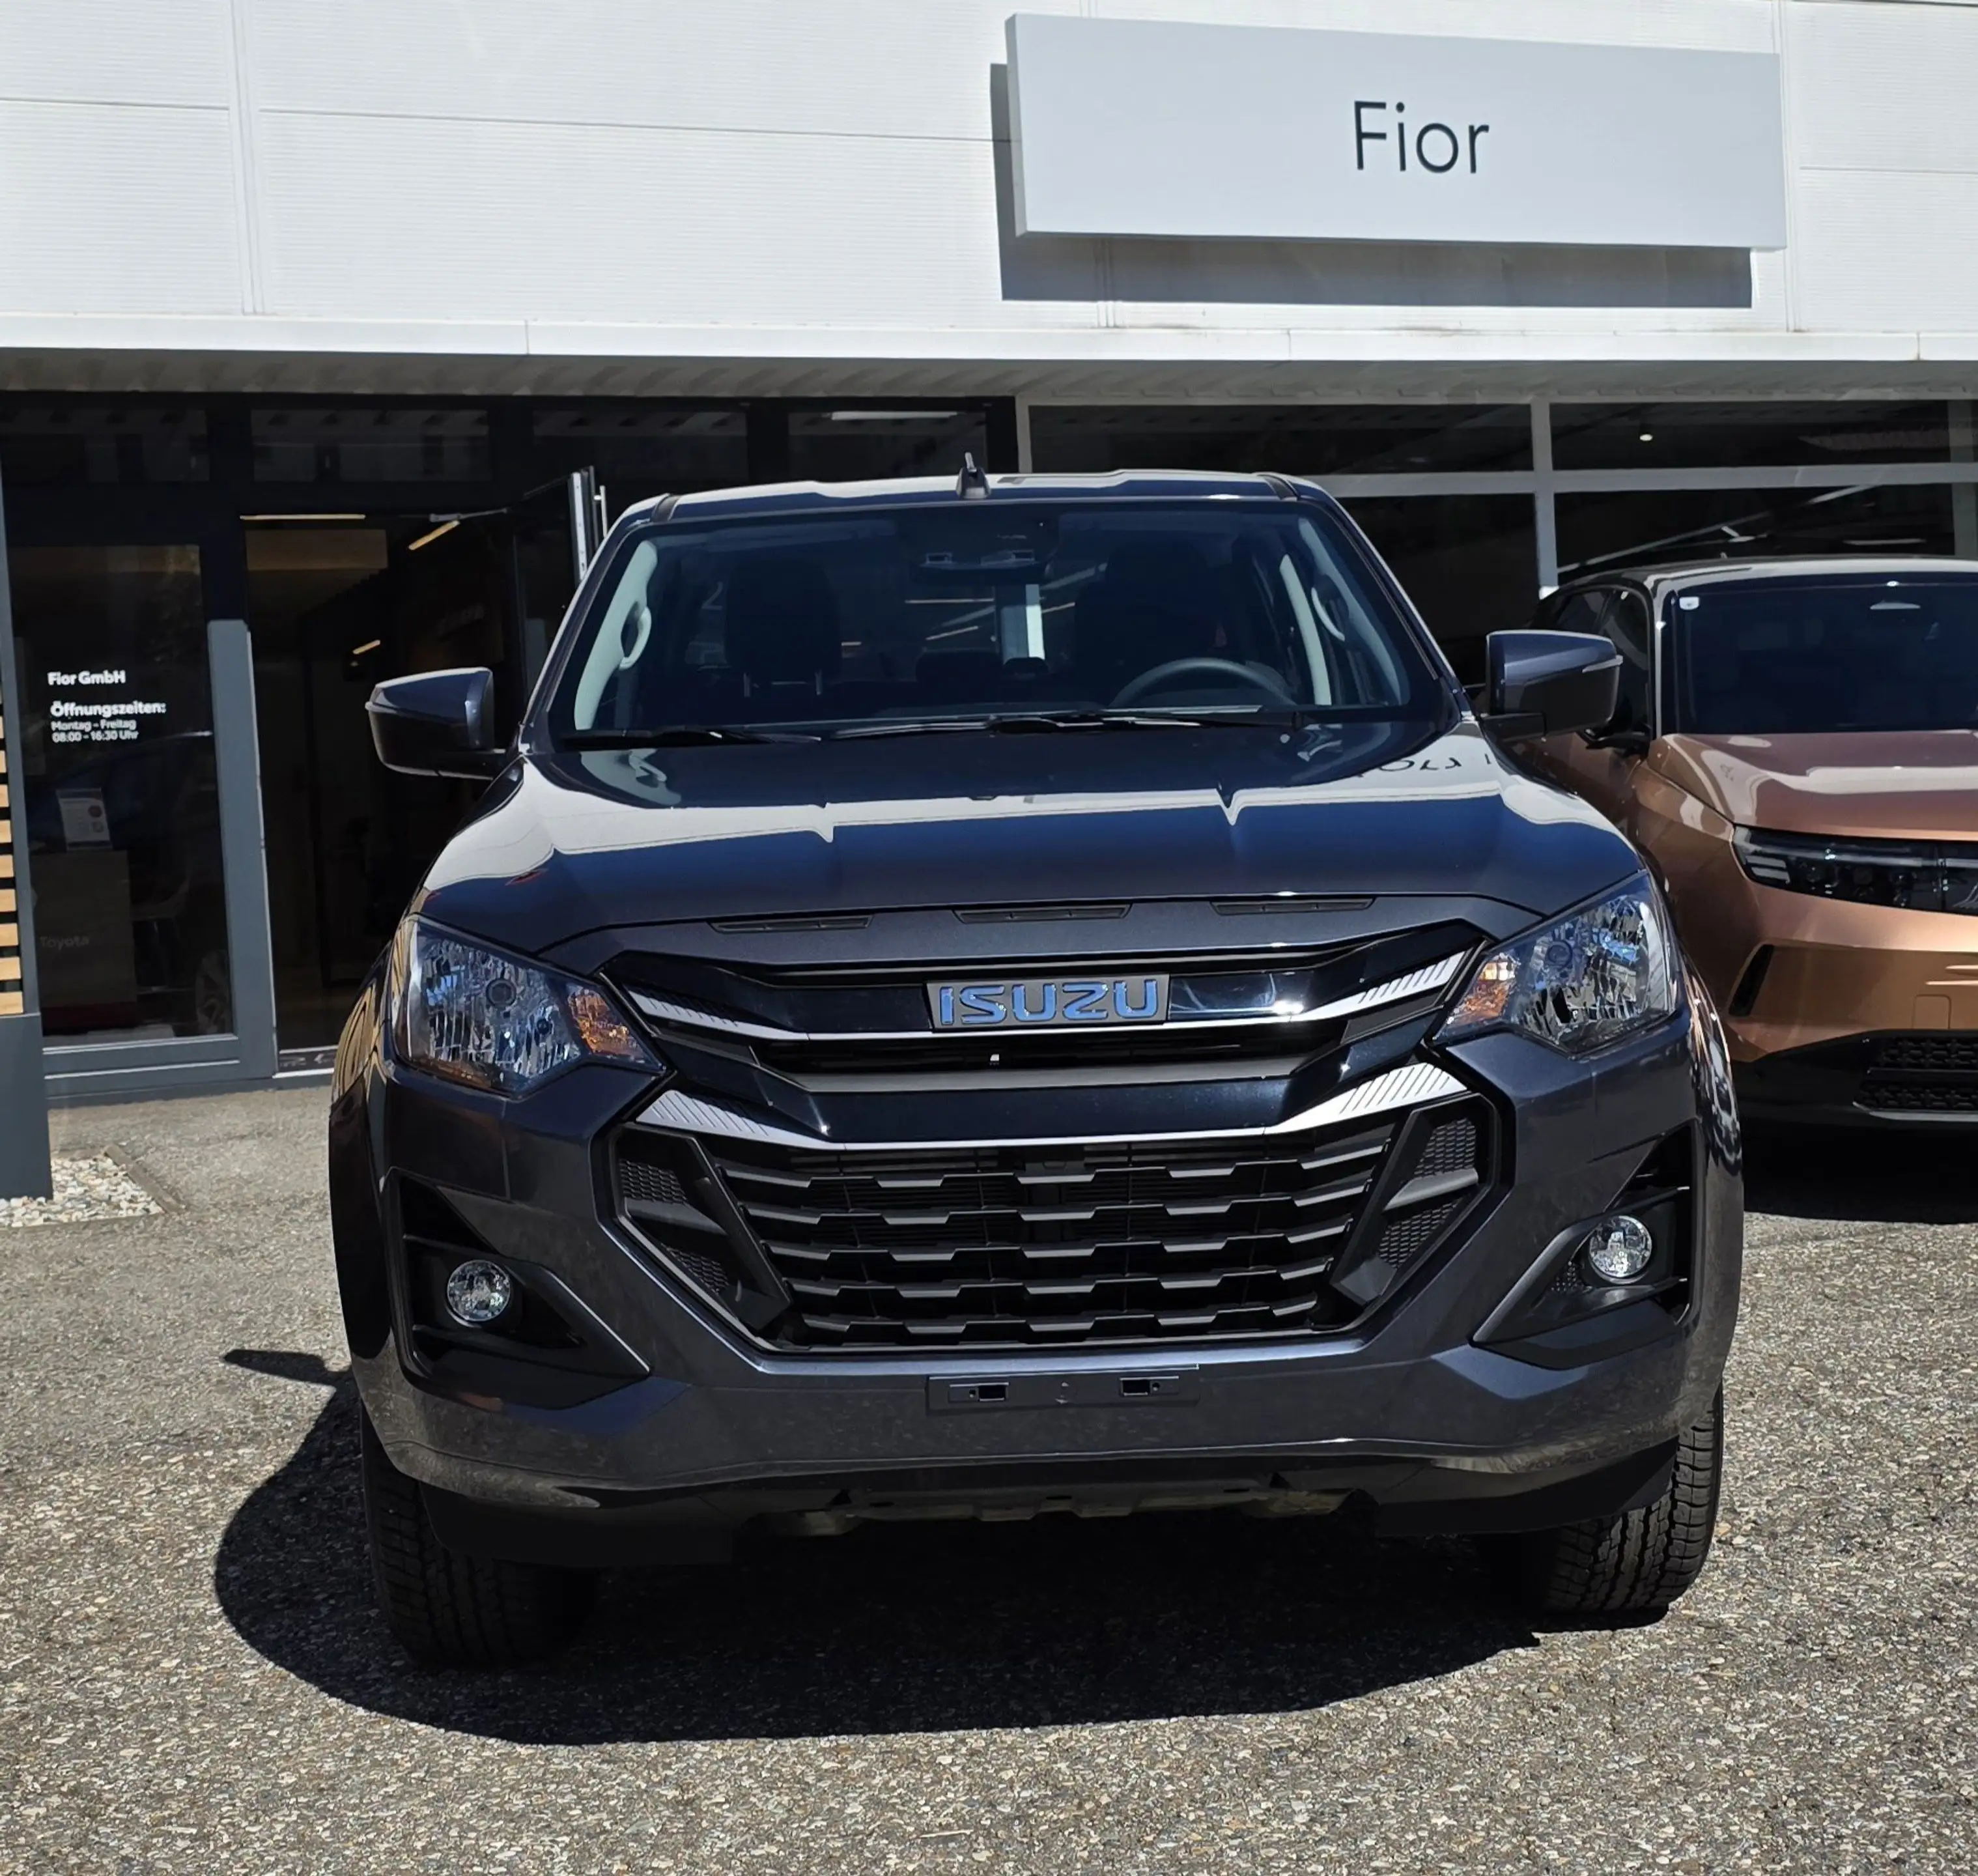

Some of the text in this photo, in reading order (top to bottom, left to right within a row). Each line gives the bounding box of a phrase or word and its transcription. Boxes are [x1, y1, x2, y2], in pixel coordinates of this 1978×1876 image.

[1354, 100, 1490, 173] Fior
[48, 670, 126, 685] Fior GmbH
[50, 700, 166, 717] Öffnungszeiten:
[51, 721, 92, 732] Montag
[100, 718, 137, 730] Freitag
[51, 732, 82, 743] 08:00
[119, 729, 139, 739] Uhr
[39, 935, 90, 950] Toyota
[939, 978, 1159, 1025] ISUZU
